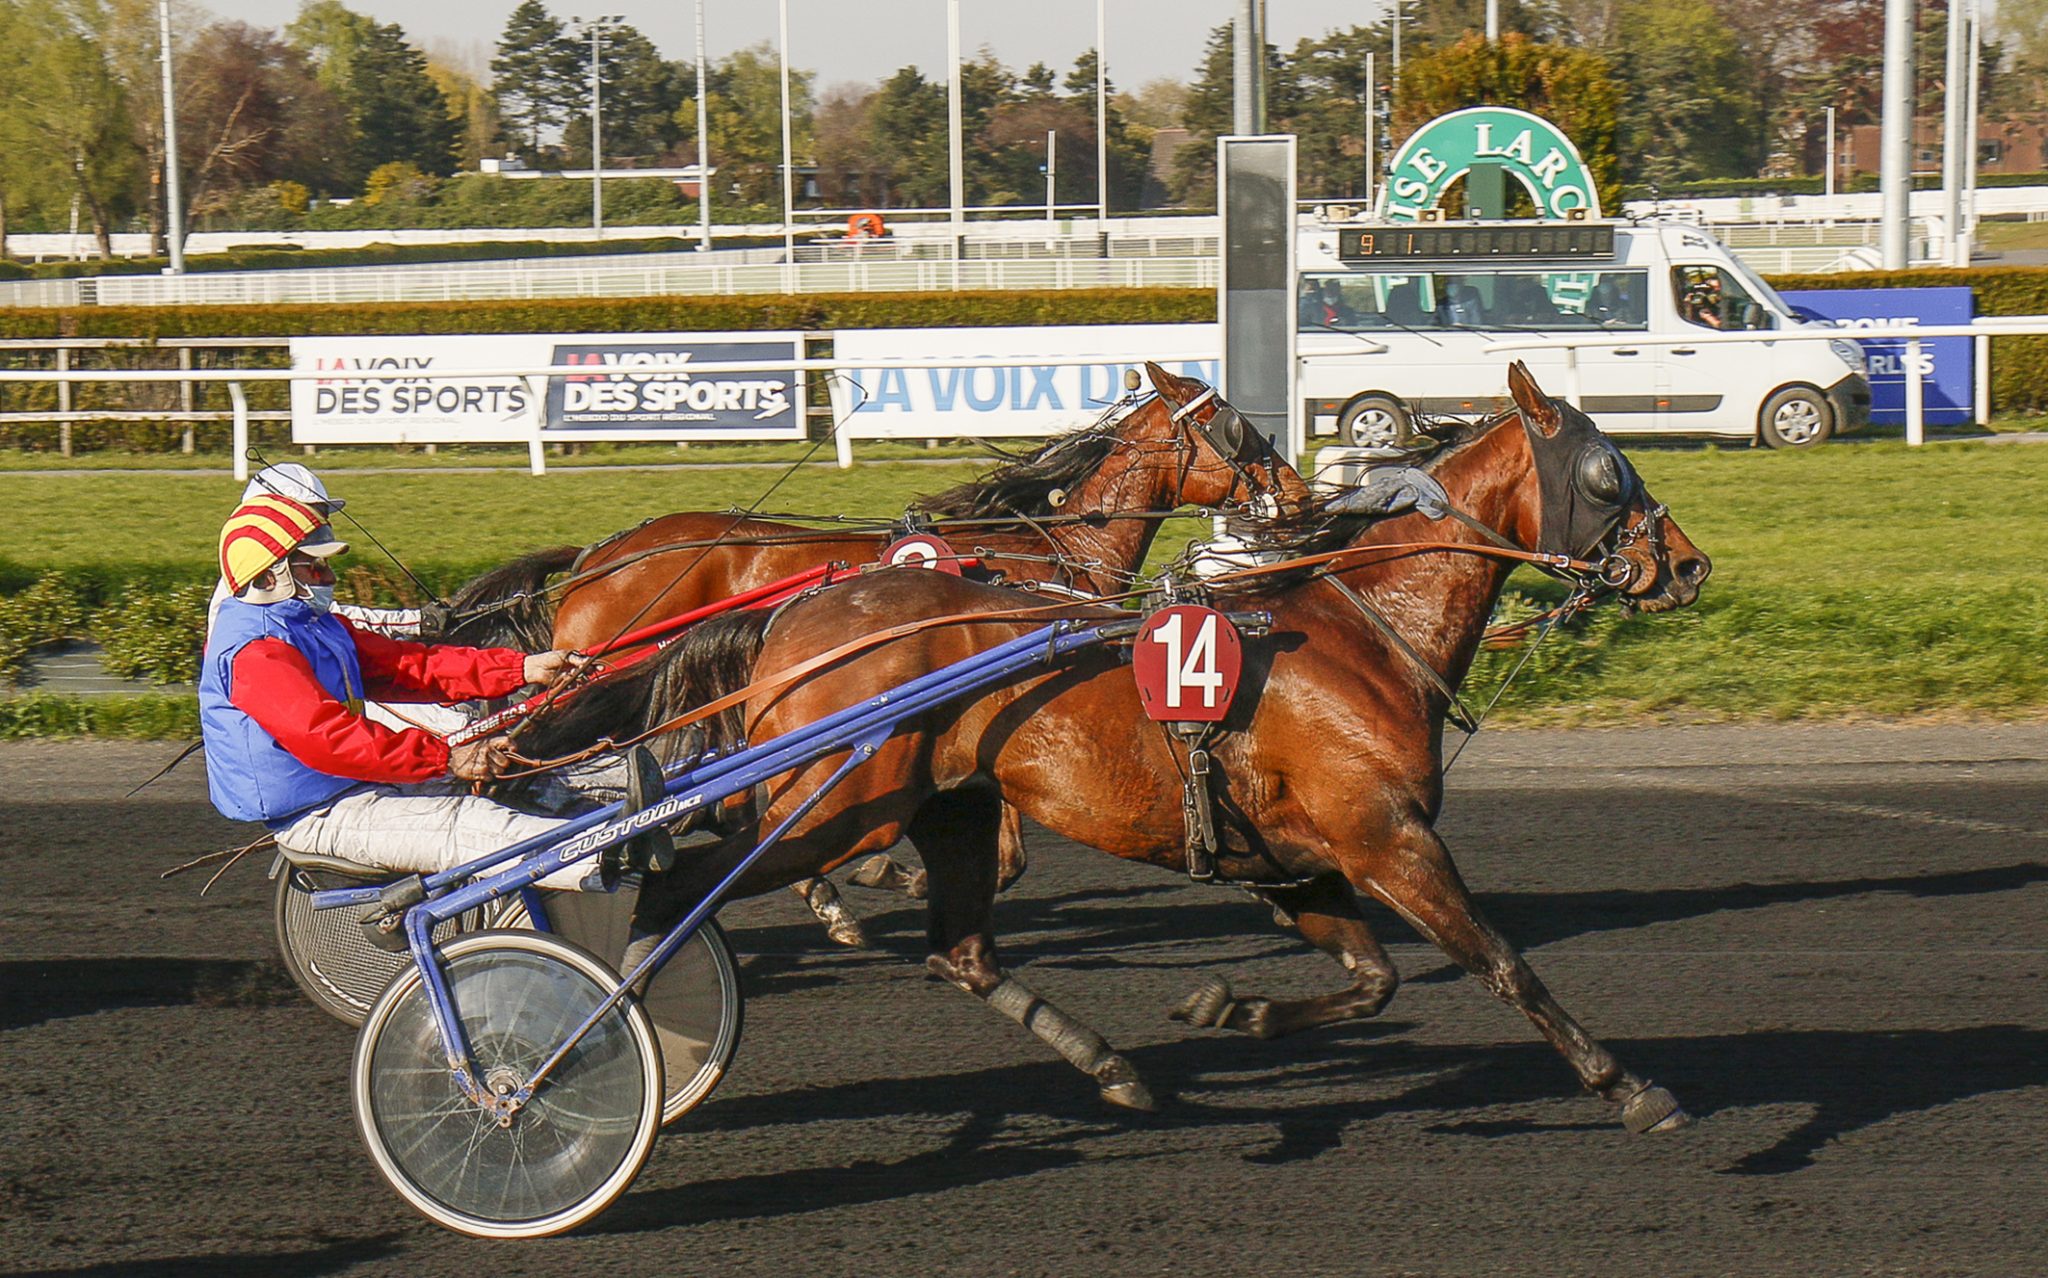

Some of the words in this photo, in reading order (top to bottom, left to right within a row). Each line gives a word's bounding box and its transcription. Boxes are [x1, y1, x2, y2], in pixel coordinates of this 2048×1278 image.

[1360, 234, 1374, 255] 9
[316, 357, 350, 384] LA
[354, 356, 434, 384] VOIX
[565, 353, 606, 382] LA
[603, 351, 692, 382] VOIX
[563, 381, 639, 412] DES
[641, 380, 788, 412] SPORTS
[852, 357, 912, 412] LA
[923, 355, 1065, 411] VOIX
[316, 386, 381, 415] DES
[392, 385, 526, 414] SPORTS
[1153, 614, 1223, 708] 14
[558, 799, 679, 863] CUSTOM
